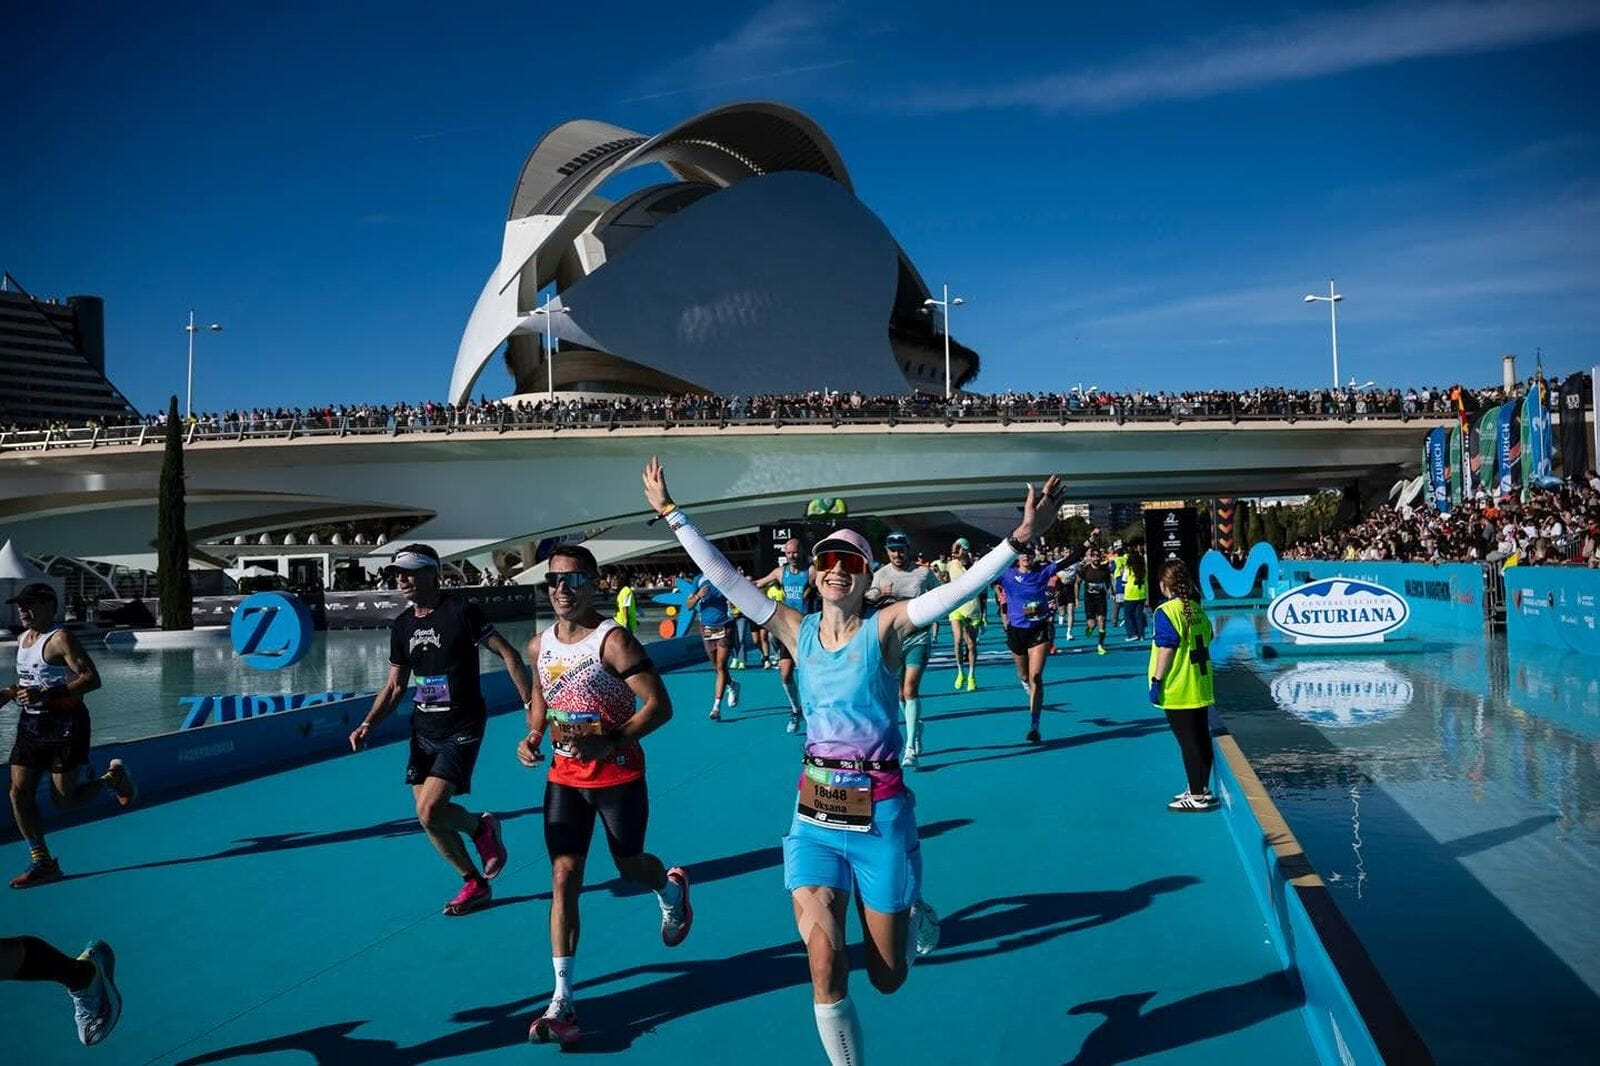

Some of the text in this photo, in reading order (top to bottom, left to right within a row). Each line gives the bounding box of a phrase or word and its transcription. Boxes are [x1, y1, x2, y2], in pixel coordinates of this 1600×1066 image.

[1502, 423, 1511, 470] ZURICH
[1434, 443, 1445, 482] ZURICH
[1283, 603, 1397, 624] ASTURIANA
[814, 800, 847, 814] Oksana
